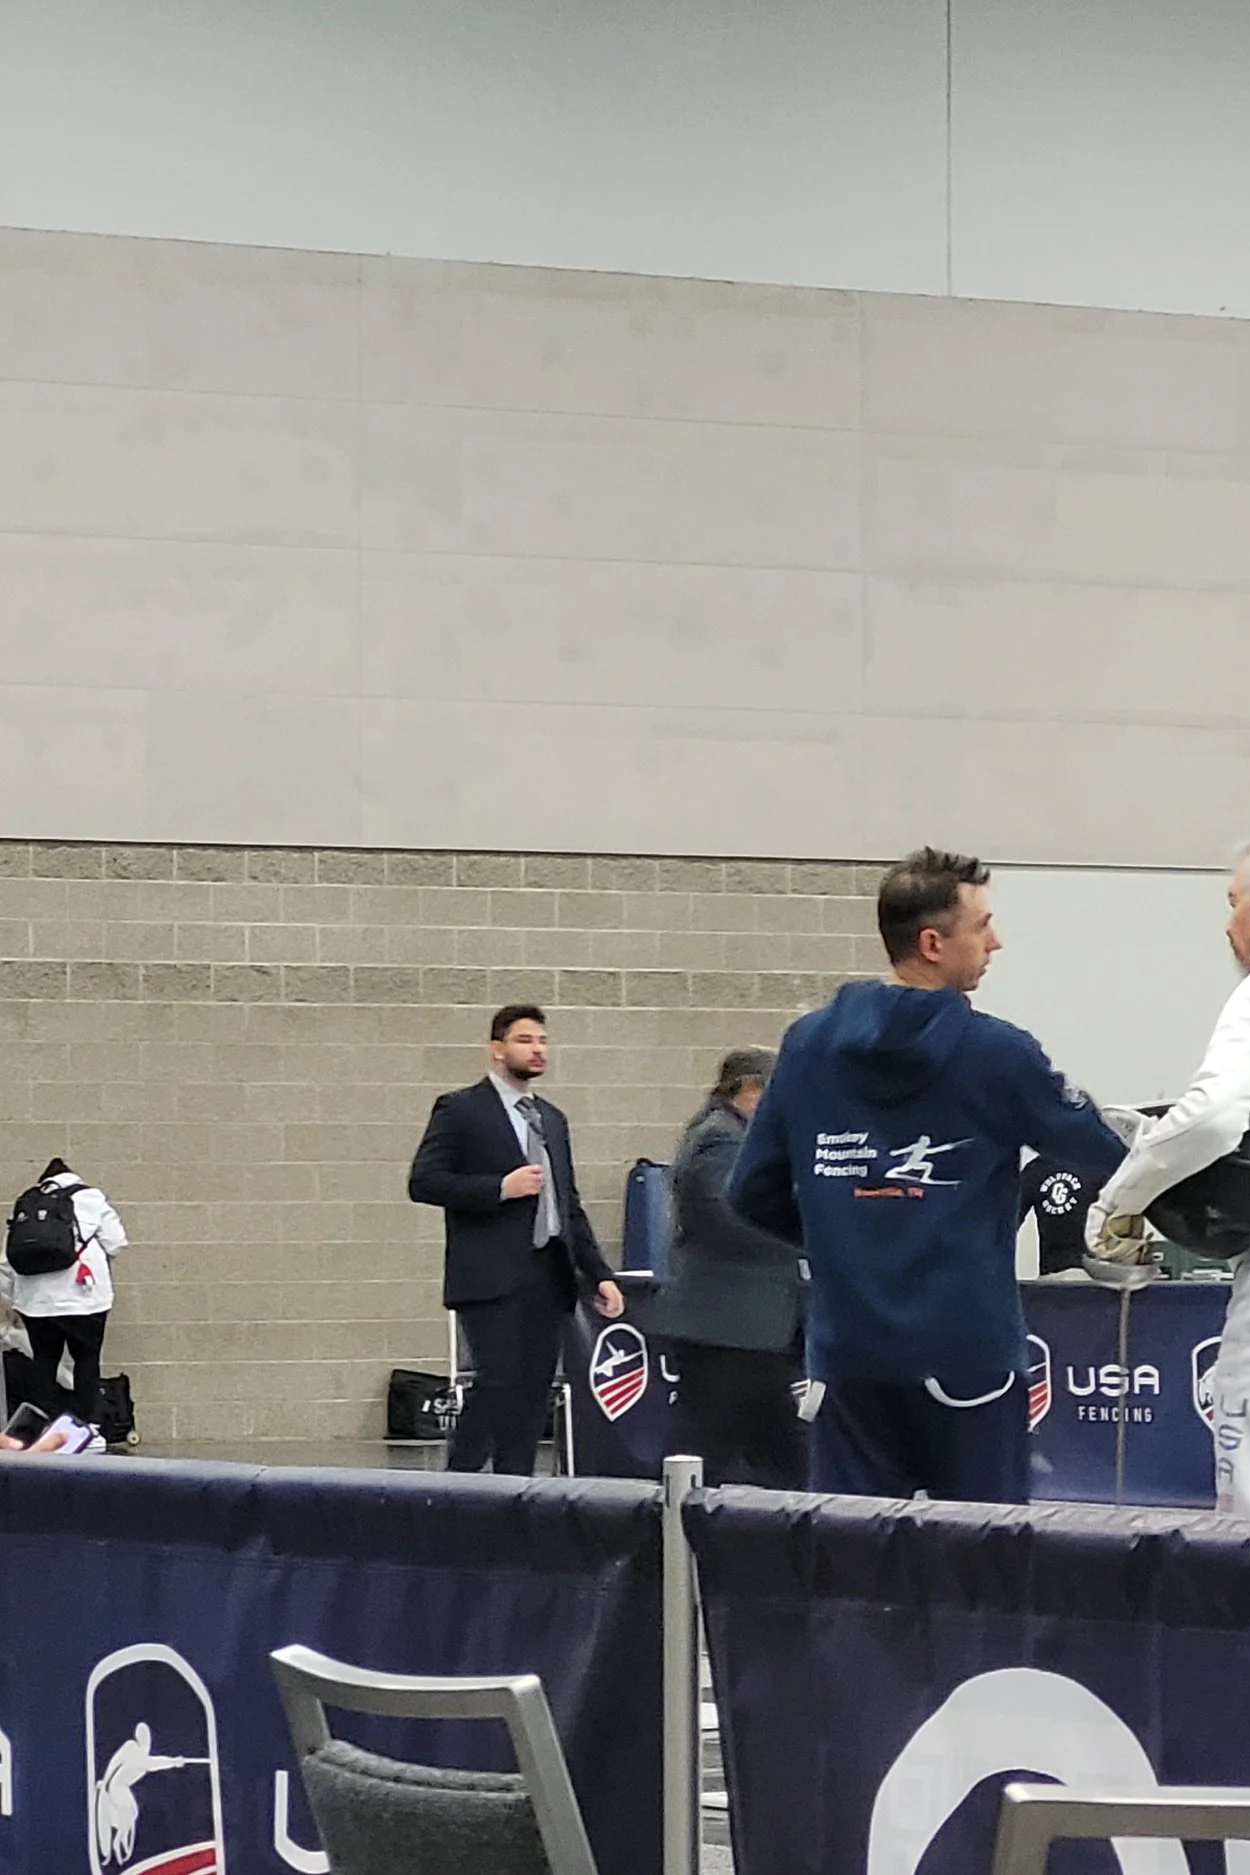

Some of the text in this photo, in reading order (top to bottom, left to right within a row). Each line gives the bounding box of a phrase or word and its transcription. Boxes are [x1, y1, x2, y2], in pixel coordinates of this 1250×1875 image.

[814, 1163, 868, 1178] Fencing
[1067, 1364, 1160, 1397] USA
[1078, 1405, 1153, 1423] FENCING
